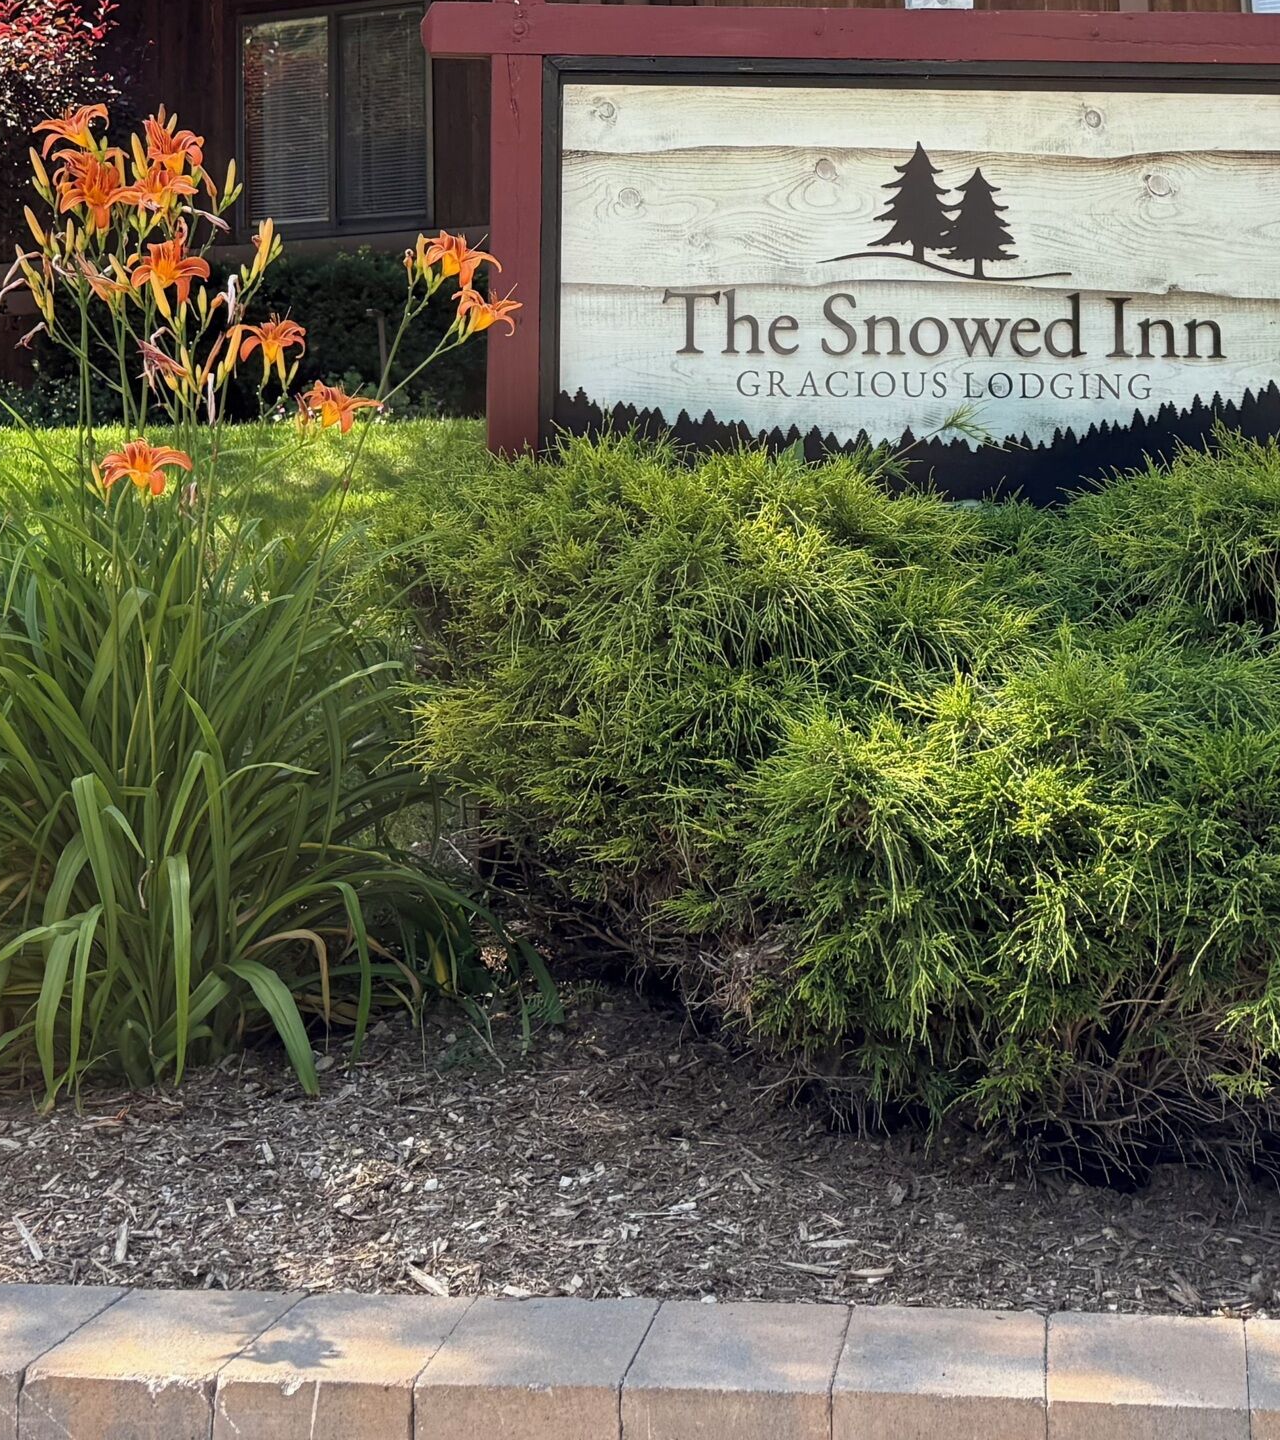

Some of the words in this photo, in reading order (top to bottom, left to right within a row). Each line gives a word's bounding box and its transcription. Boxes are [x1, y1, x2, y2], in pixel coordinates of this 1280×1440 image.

[662, 286, 800, 357] The
[821, 291, 1087, 359] Snowed
[1106, 295, 1227, 360] Inn
[736, 369, 948, 400] GRACIOUS
[963, 371, 1153, 401] LODGING
